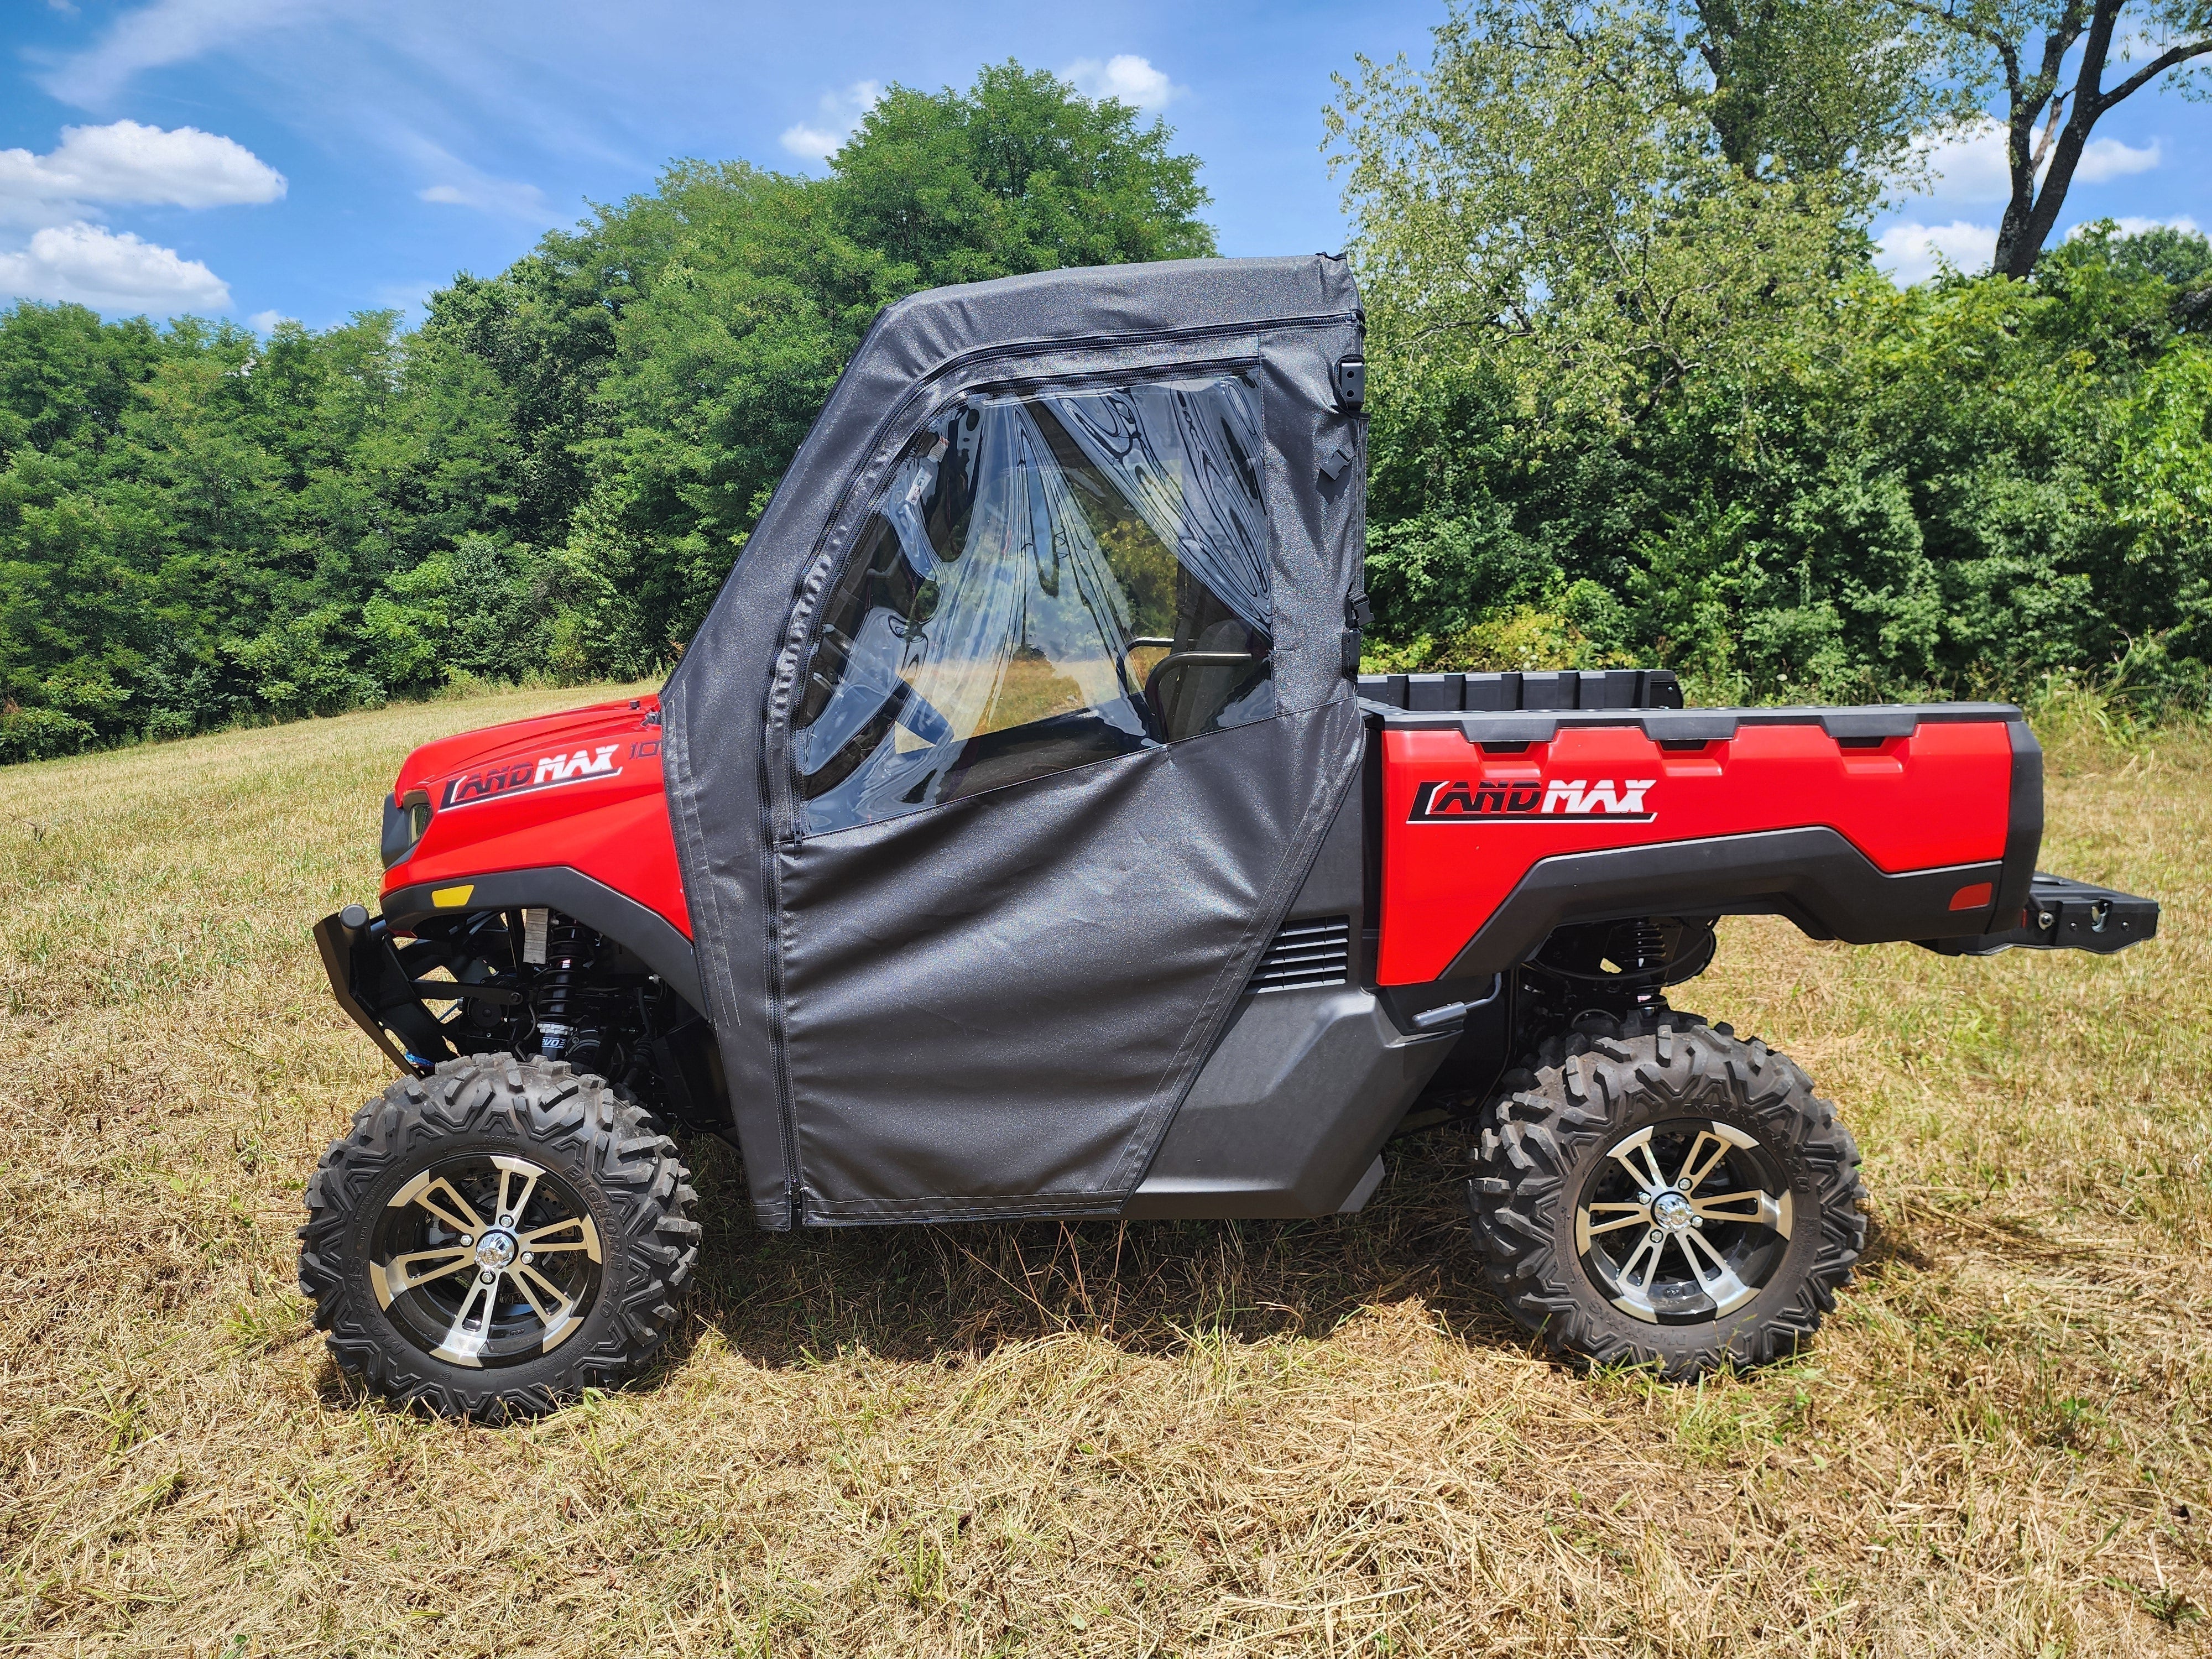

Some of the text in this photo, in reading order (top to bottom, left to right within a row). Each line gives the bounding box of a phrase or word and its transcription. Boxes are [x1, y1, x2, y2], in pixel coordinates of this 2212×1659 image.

[437, 744, 623, 813] LANDMAX
[1406, 779, 1658, 824] LANDMAX
[563, 1165, 623, 1271] BIGHORN
[599, 1277, 620, 1318] 2.0
[348, 1256, 406, 1355] MAXXIS
